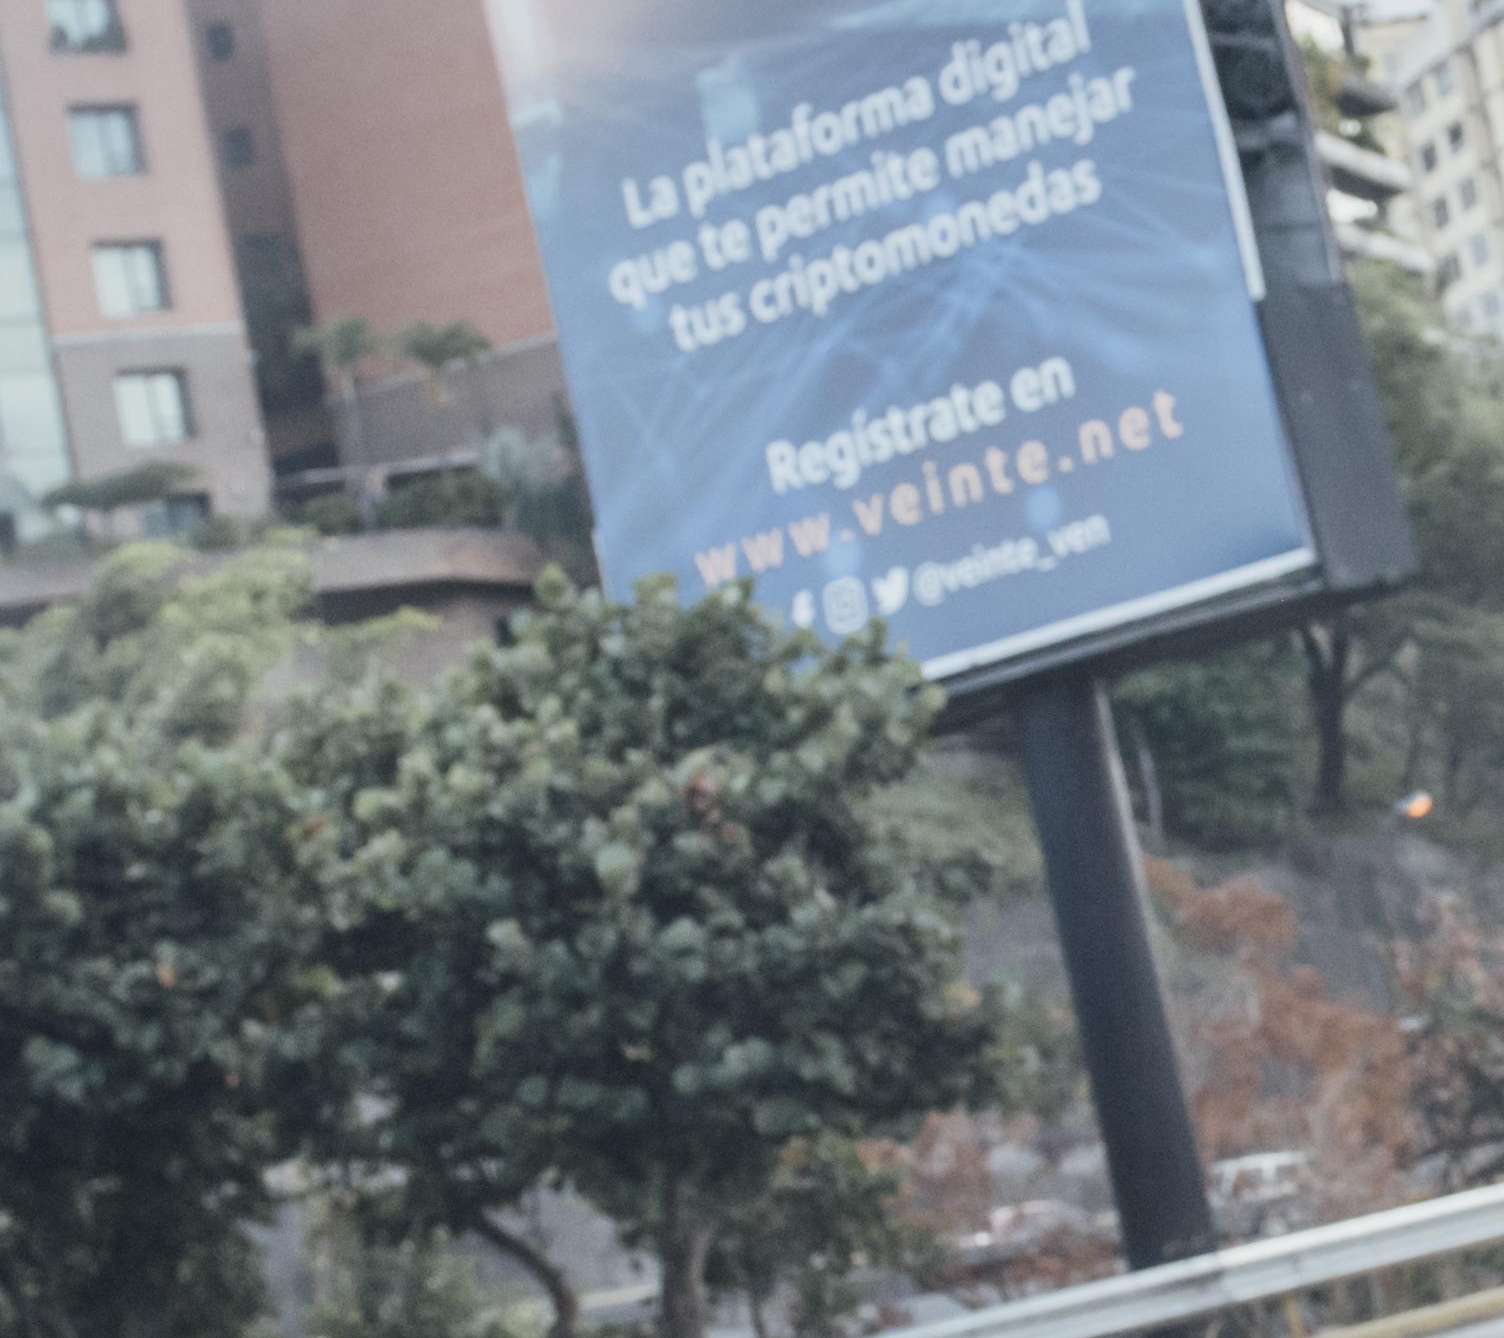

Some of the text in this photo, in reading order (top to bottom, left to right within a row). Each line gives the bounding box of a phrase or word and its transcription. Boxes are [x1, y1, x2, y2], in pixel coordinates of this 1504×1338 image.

[608, 65, 1137, 311] que te permite manejar
[620, 175, 680, 229] La
[682, 73, 935, 219] plataforma
[668, 159, 1103, 353] tus criptomonedas
[1009, 356, 1076, 413] en
[694, 389, 1183, 588] www.veinte.net
